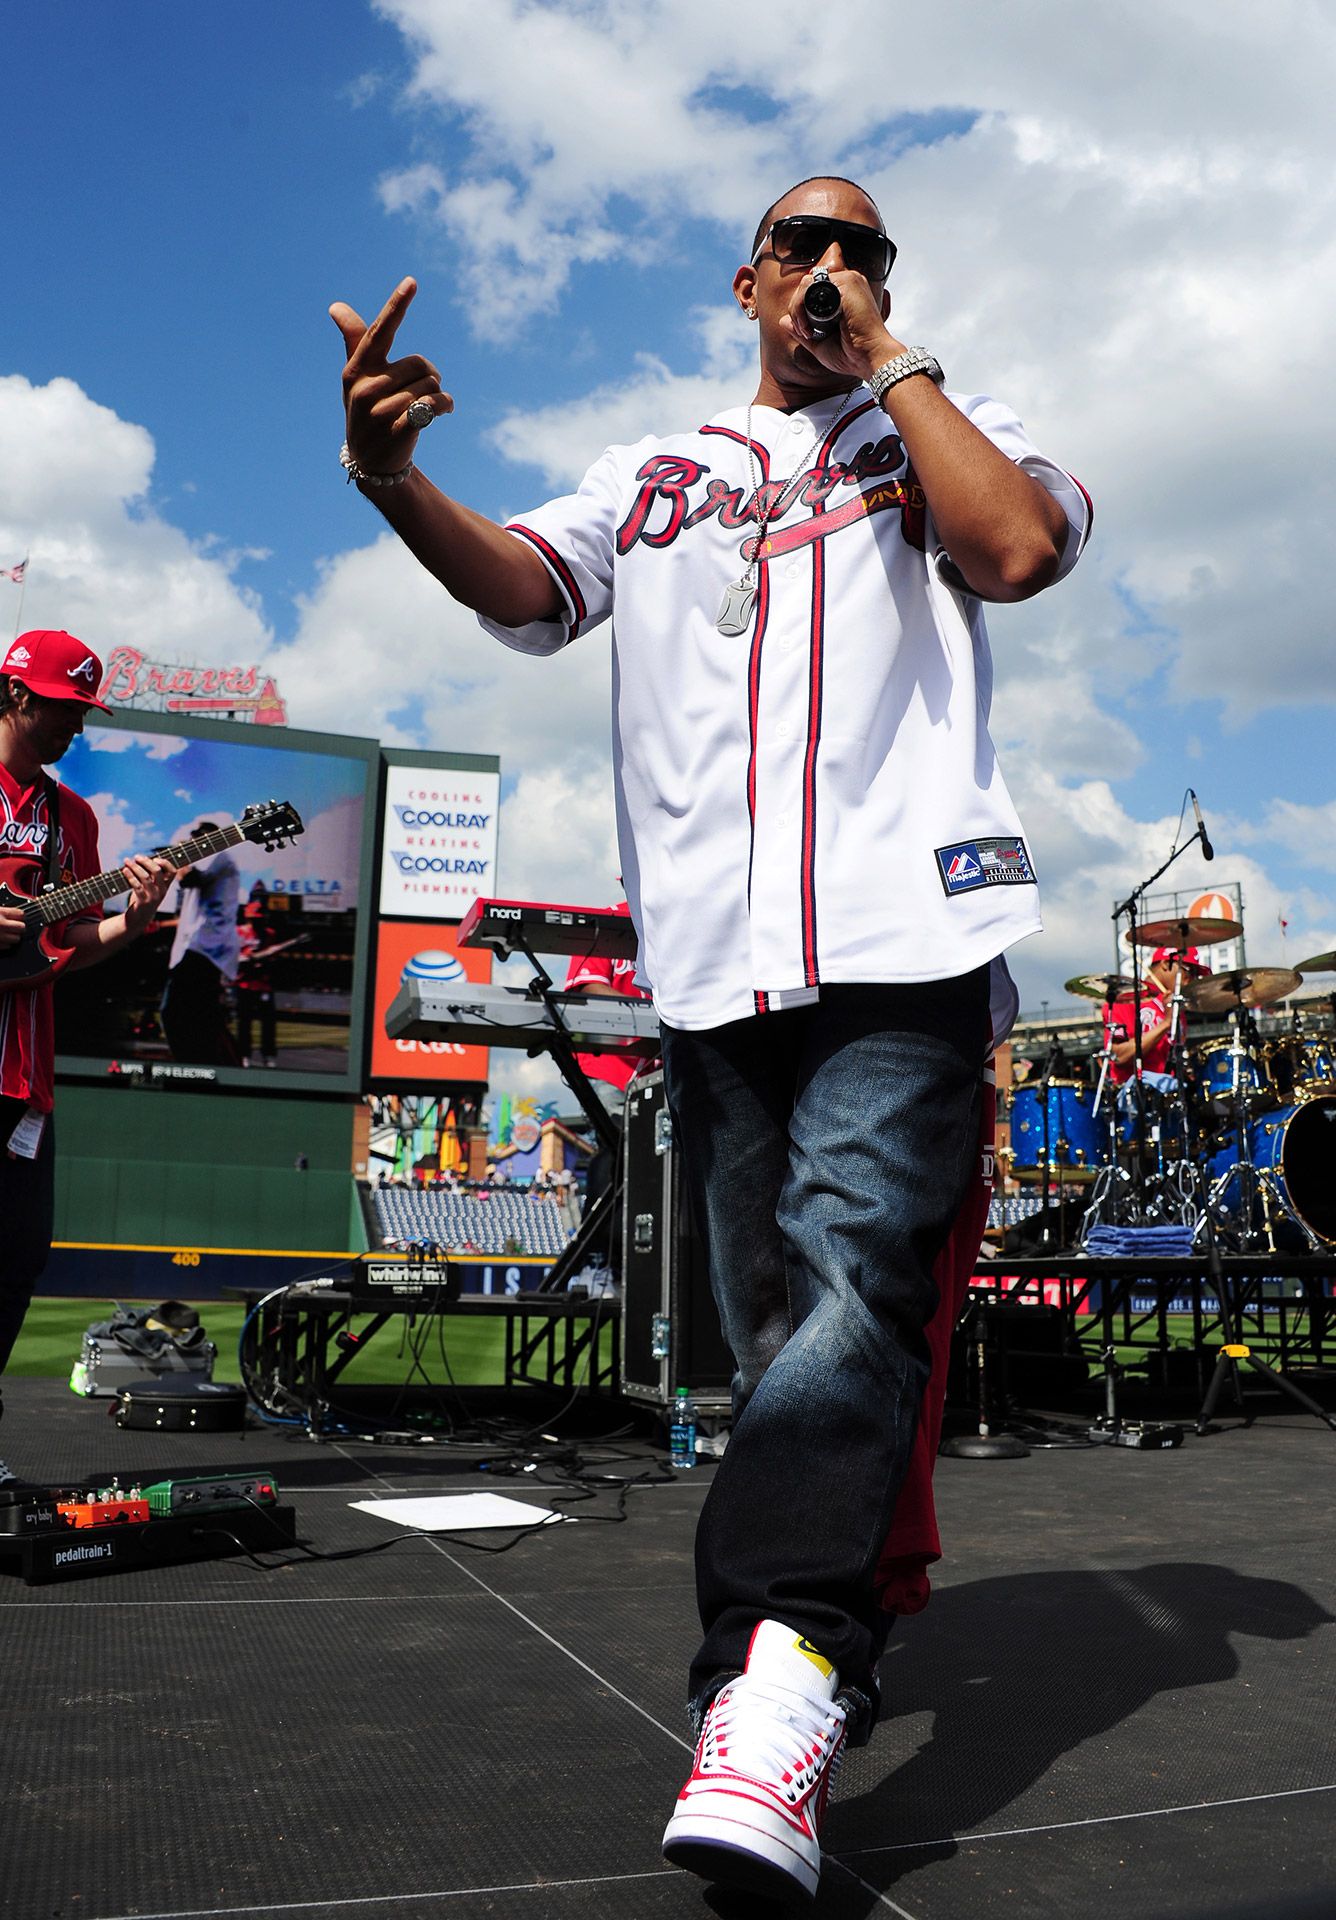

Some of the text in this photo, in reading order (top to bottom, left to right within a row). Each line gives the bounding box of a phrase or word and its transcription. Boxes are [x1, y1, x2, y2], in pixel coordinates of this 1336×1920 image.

[616, 434, 906, 555] Braves
[66, 656, 94, 682] A
[98, 646, 260, 701] Braves
[408, 790, 482, 804] COOLING
[401, 810, 491, 829] COOLRAY
[406, 836, 480, 849] HEATING
[399, 856, 488, 875] COOLRAY
[948, 869, 981, 883] Majestic
[272, 879, 341, 893] DELTA
[403, 883, 479, 896] PLUMBING
[489, 907, 522, 920] nord
[171, 1252, 201, 1267] 400
[55, 1543, 113, 1566] pedaltrain-1
